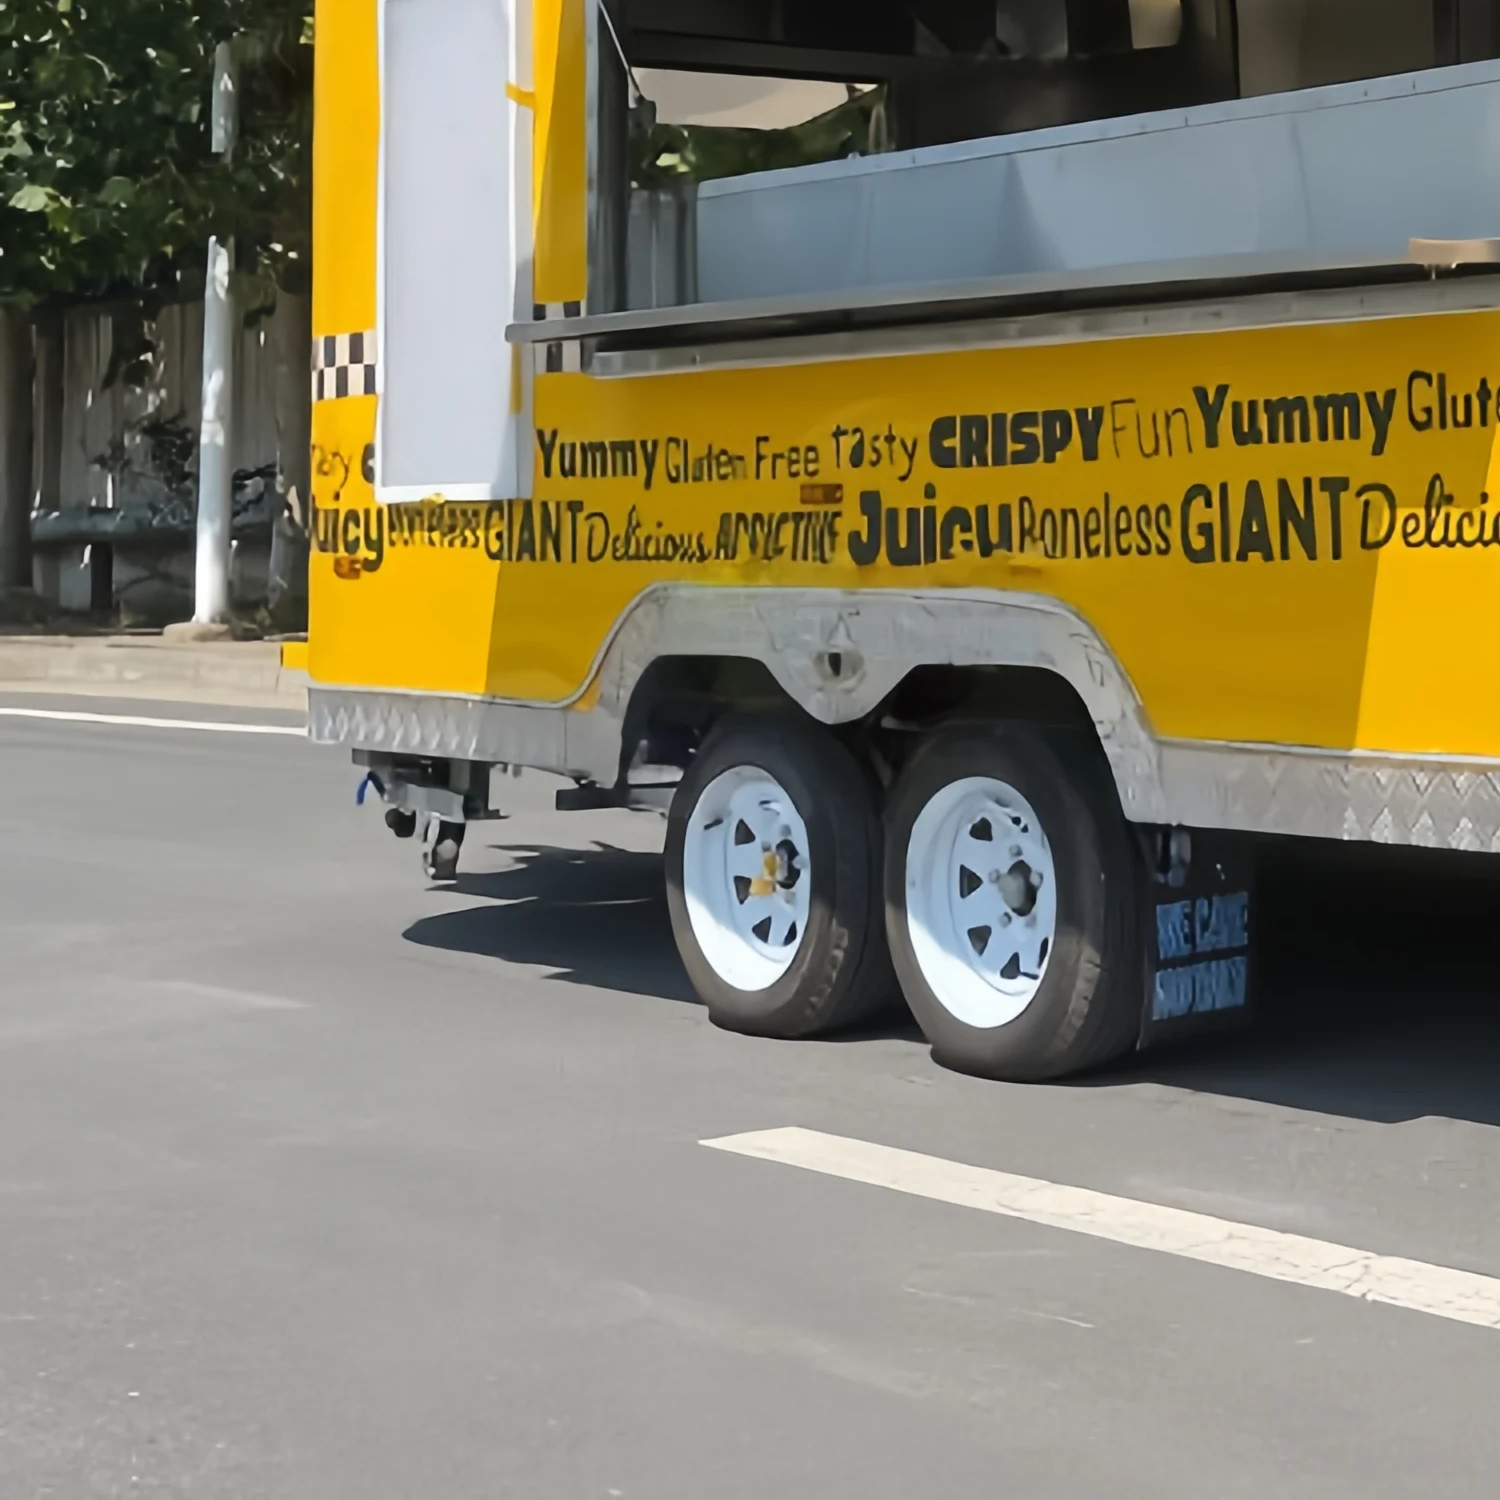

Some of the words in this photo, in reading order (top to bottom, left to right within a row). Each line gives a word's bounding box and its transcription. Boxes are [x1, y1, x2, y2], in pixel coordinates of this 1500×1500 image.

[536, 428, 659, 491] Yummy
[755, 435, 820, 481] Free
[928, 405, 1105, 469] CRISPY
[1110, 397, 1194, 459] Fun
[1192, 383, 1397, 457] Yummy
[309, 496, 384, 572] uicy
[485, 498, 585, 564] GIANT
[1180, 475, 1350, 565] GIANT
